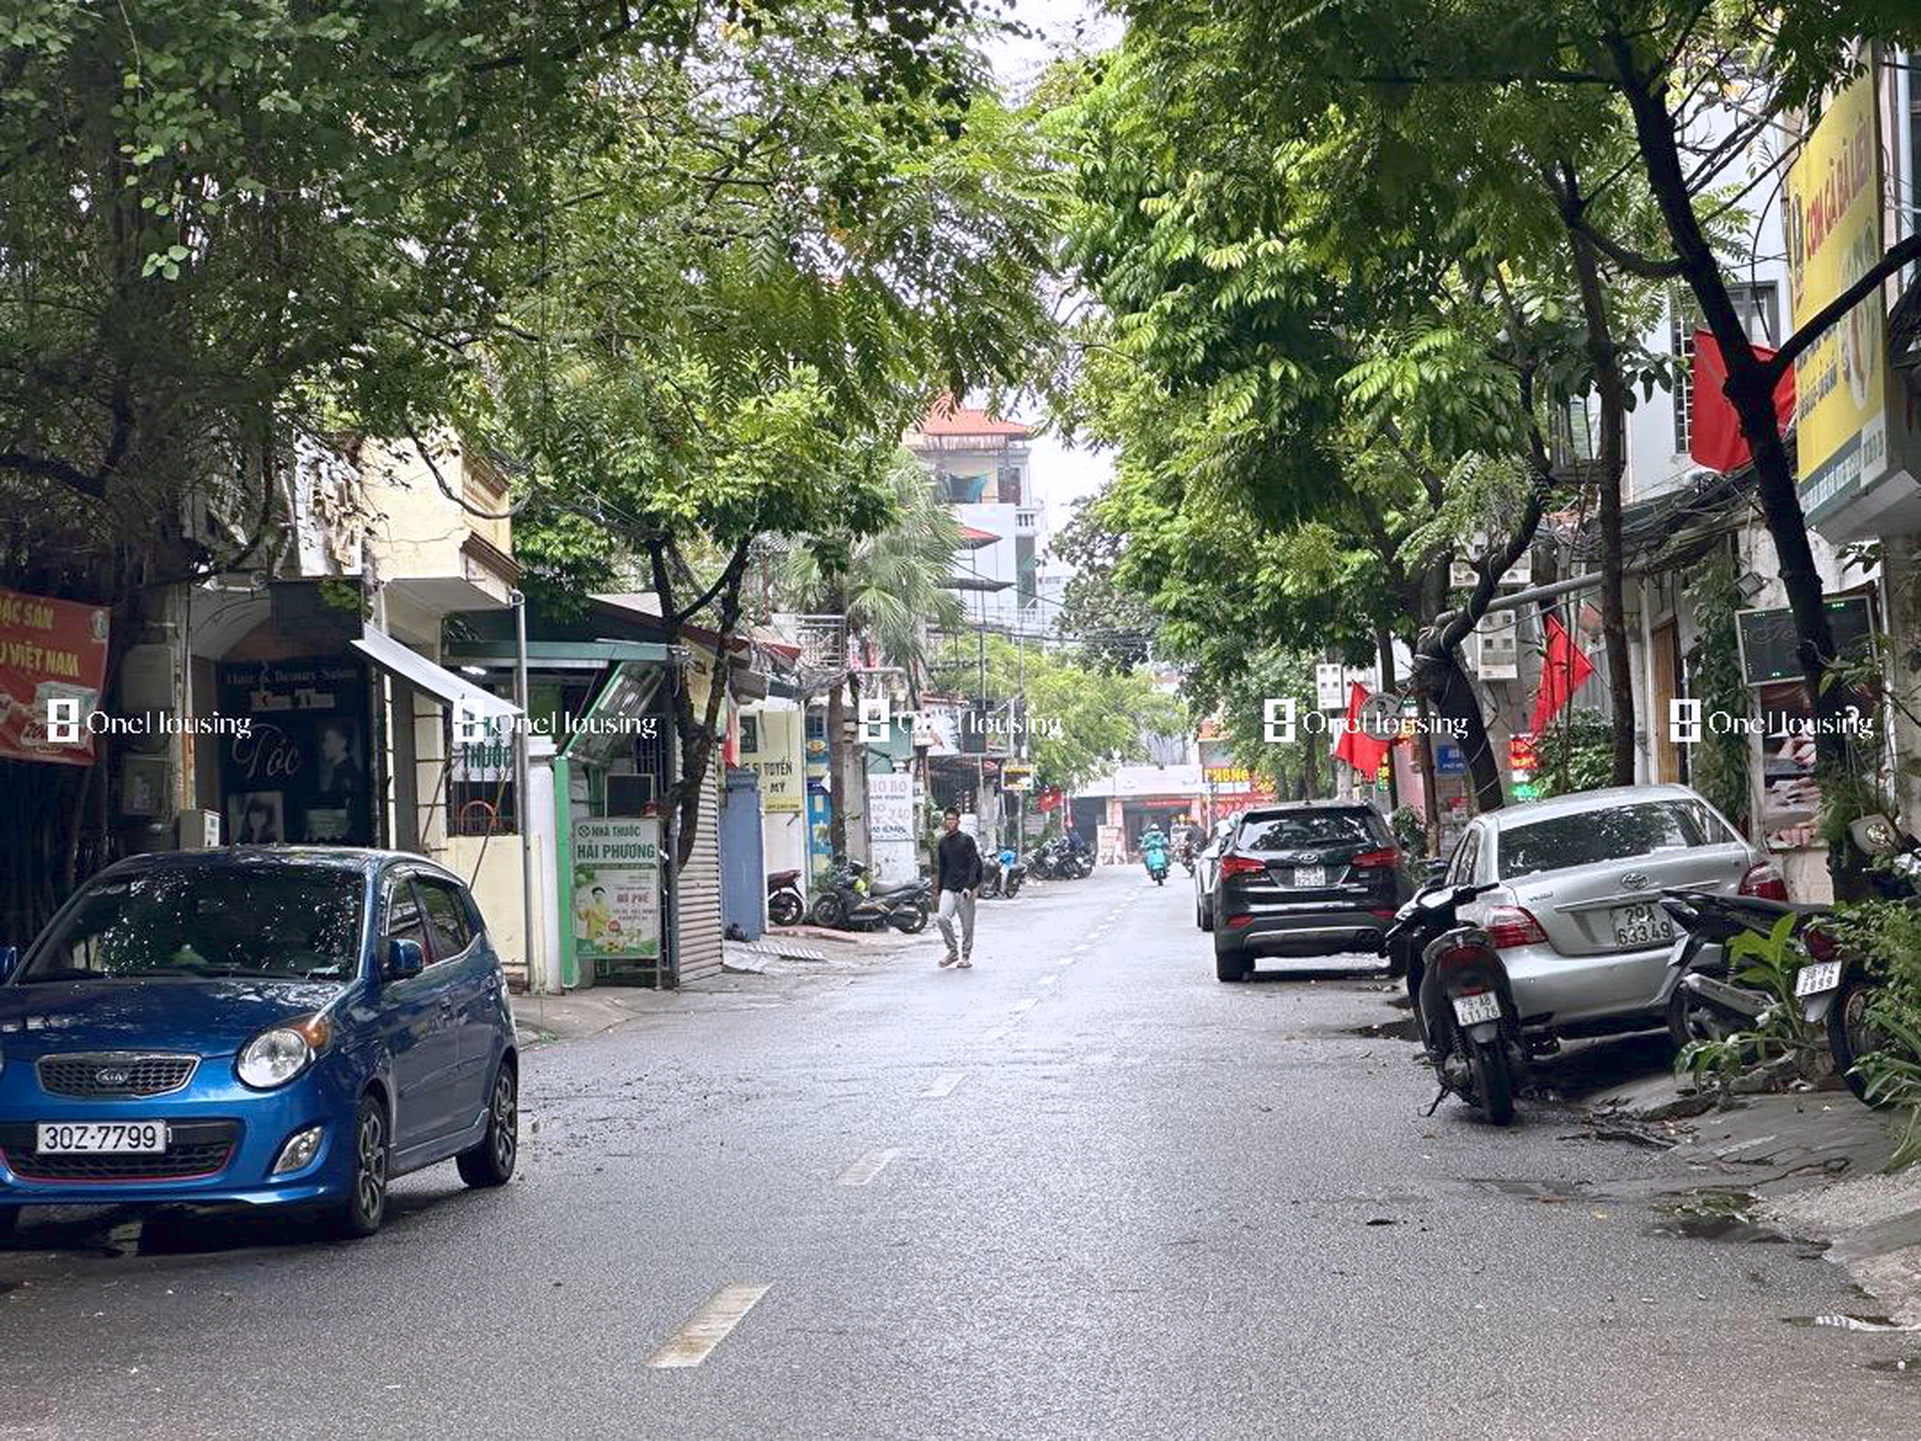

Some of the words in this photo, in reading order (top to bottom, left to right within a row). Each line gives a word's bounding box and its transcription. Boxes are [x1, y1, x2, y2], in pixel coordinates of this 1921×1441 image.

[46, 650, 80, 677] NAM
[577, 839, 598, 859] HẢI
[602, 841, 655, 859] PHƯƠNG
[1624, 904, 1657, 925] 29A
